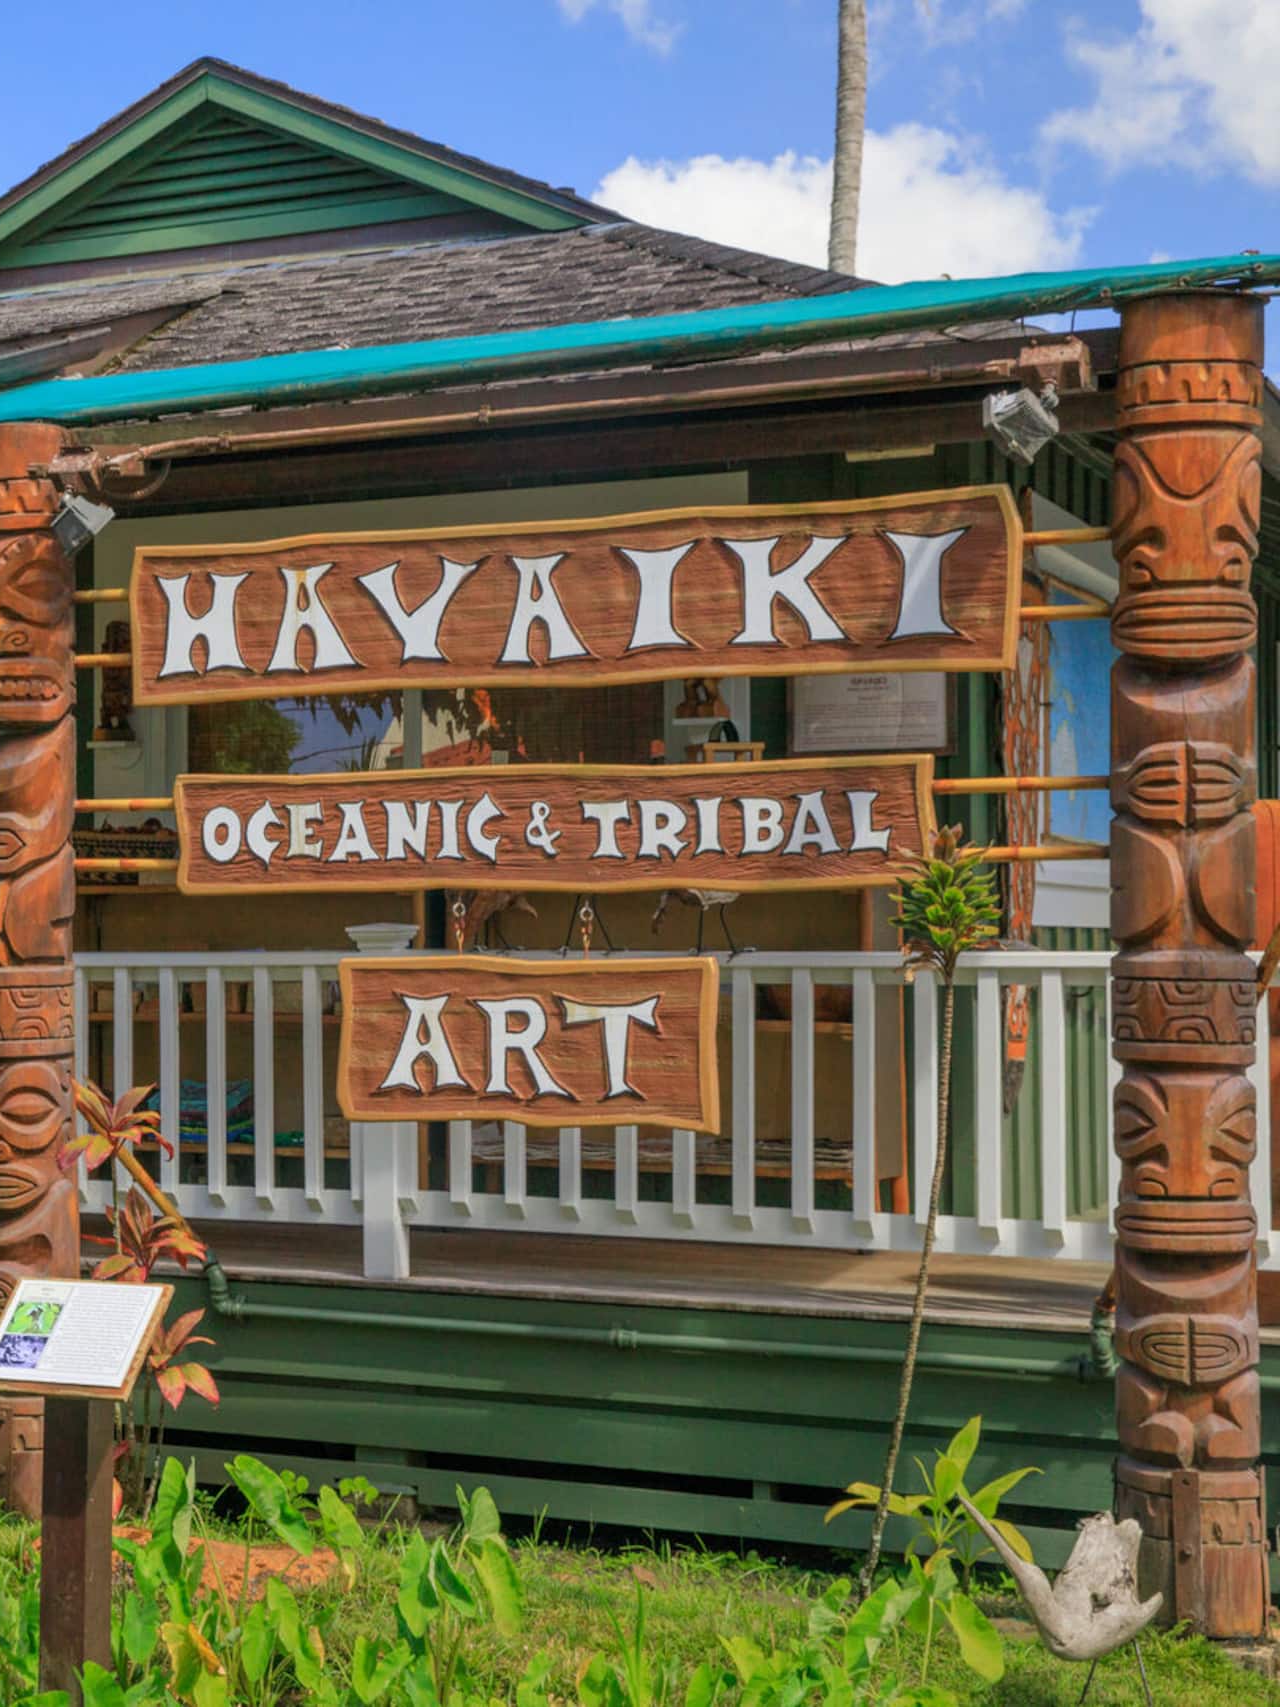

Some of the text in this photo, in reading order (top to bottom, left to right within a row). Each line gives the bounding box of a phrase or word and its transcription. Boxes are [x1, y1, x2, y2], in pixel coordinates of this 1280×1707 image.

[202, 790, 892, 871] OCEANIC & TRIBAL
[375, 993, 662, 1099] ART
